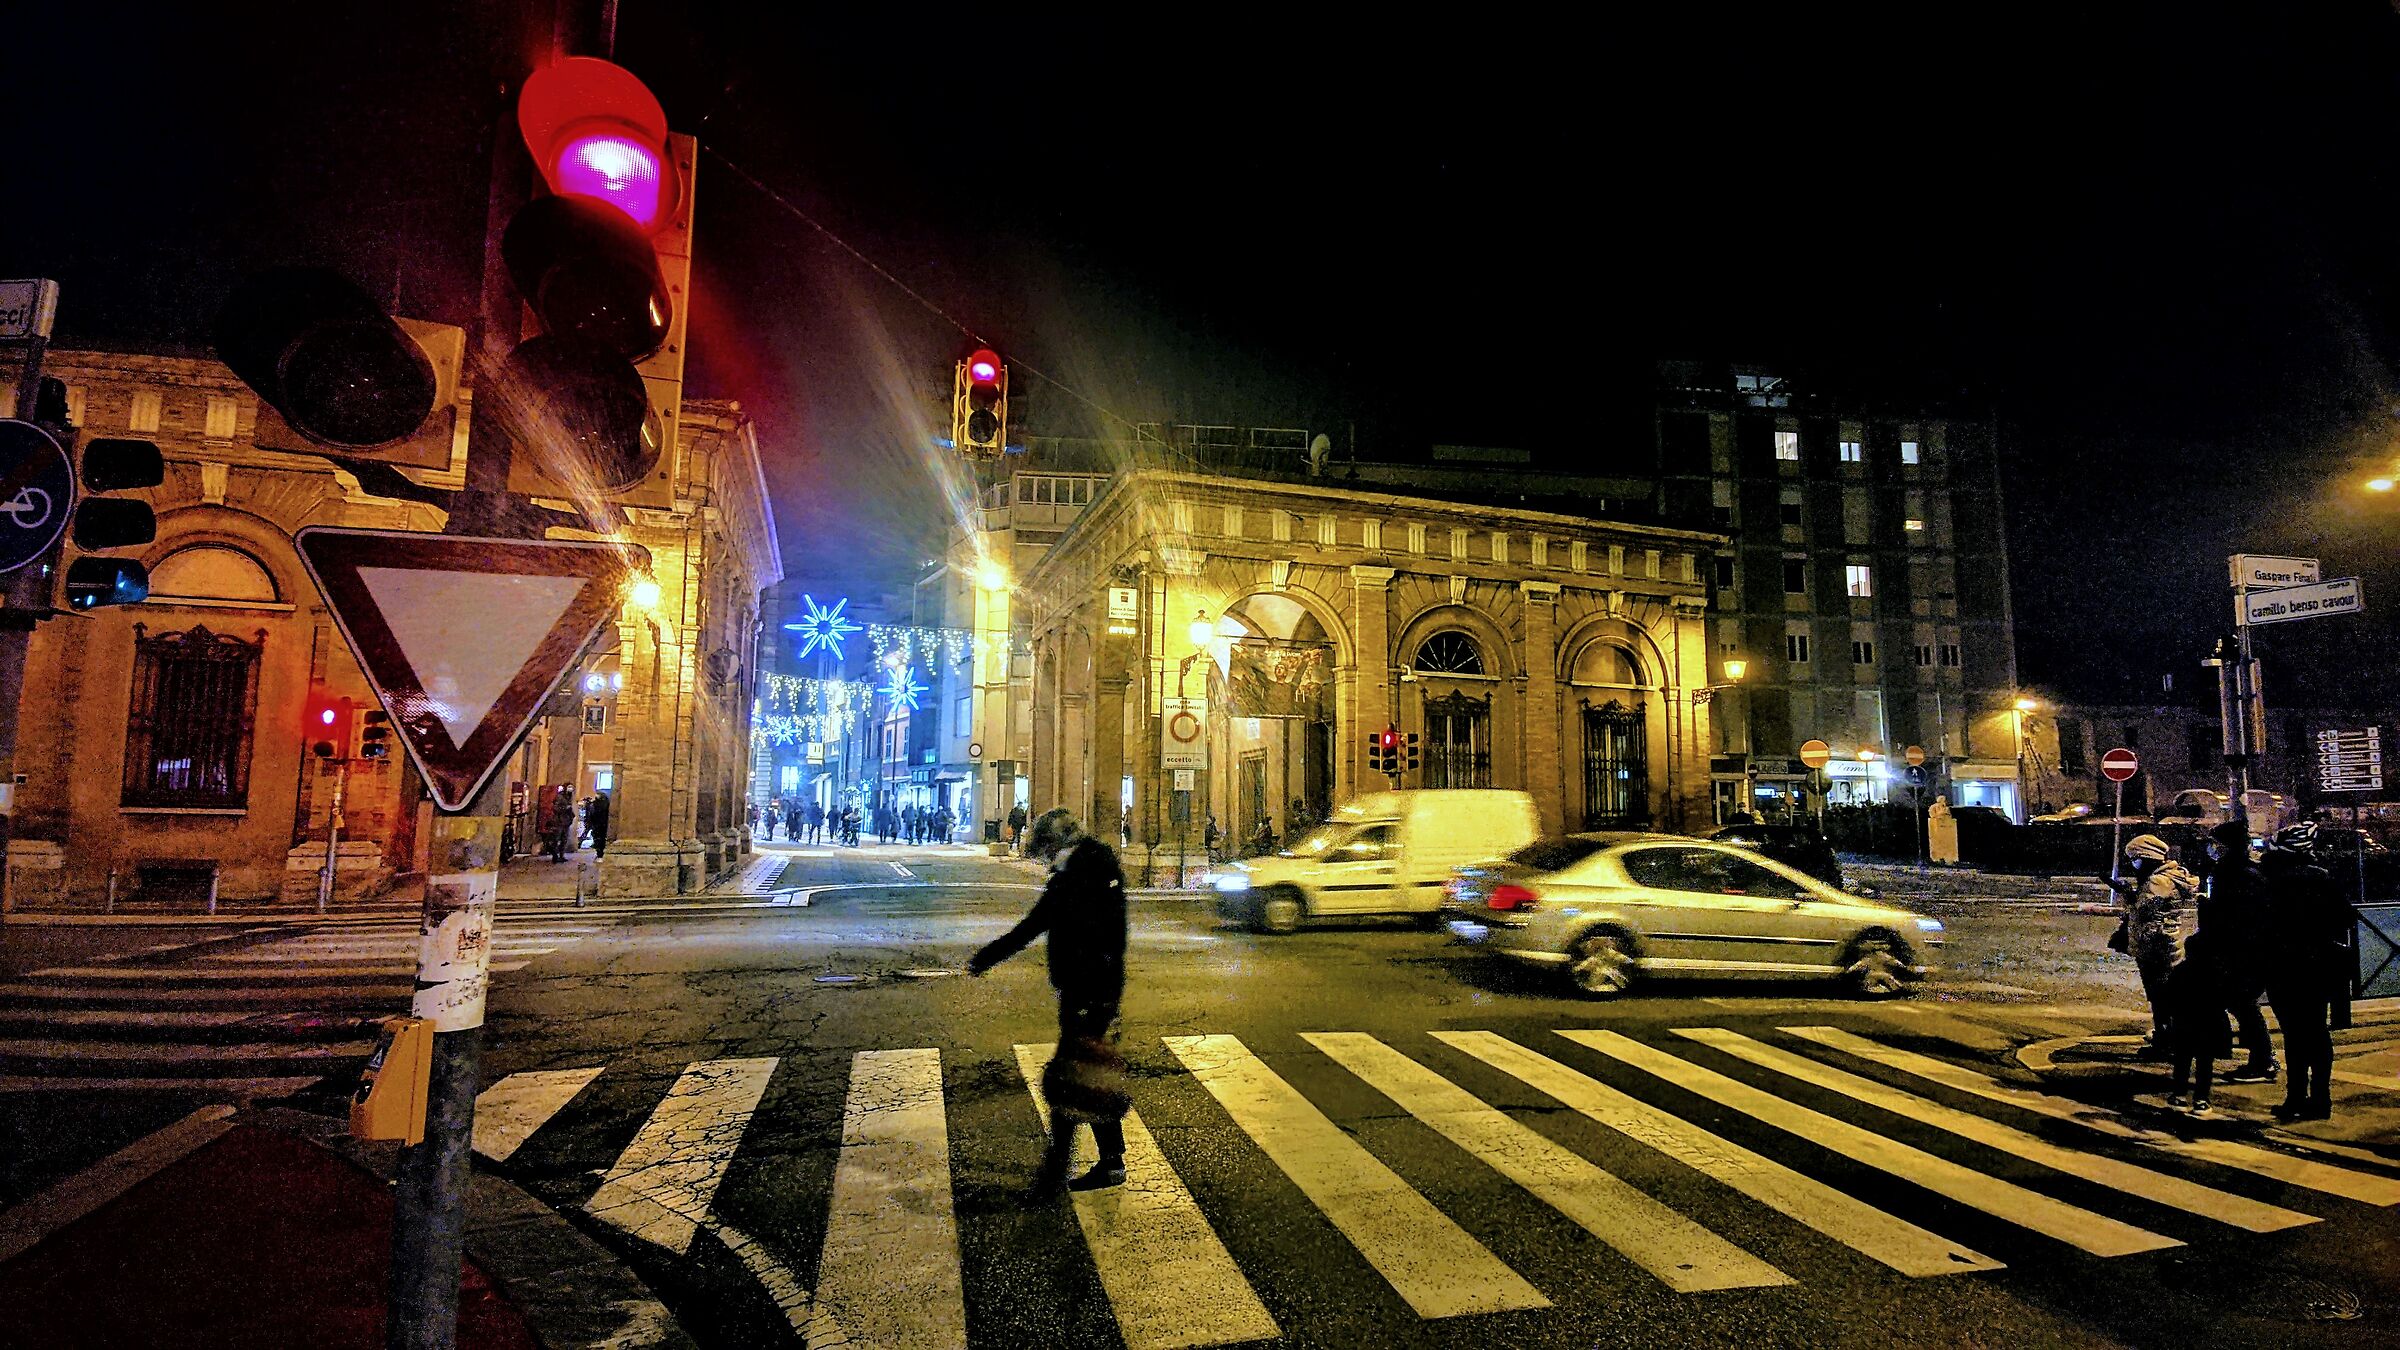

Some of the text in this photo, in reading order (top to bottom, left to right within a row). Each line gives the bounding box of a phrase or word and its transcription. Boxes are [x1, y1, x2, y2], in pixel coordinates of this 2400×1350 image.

[2254, 569, 2317, 583] Gaspare Finali
[2251, 595, 2355, 617] camillo benso cavour
